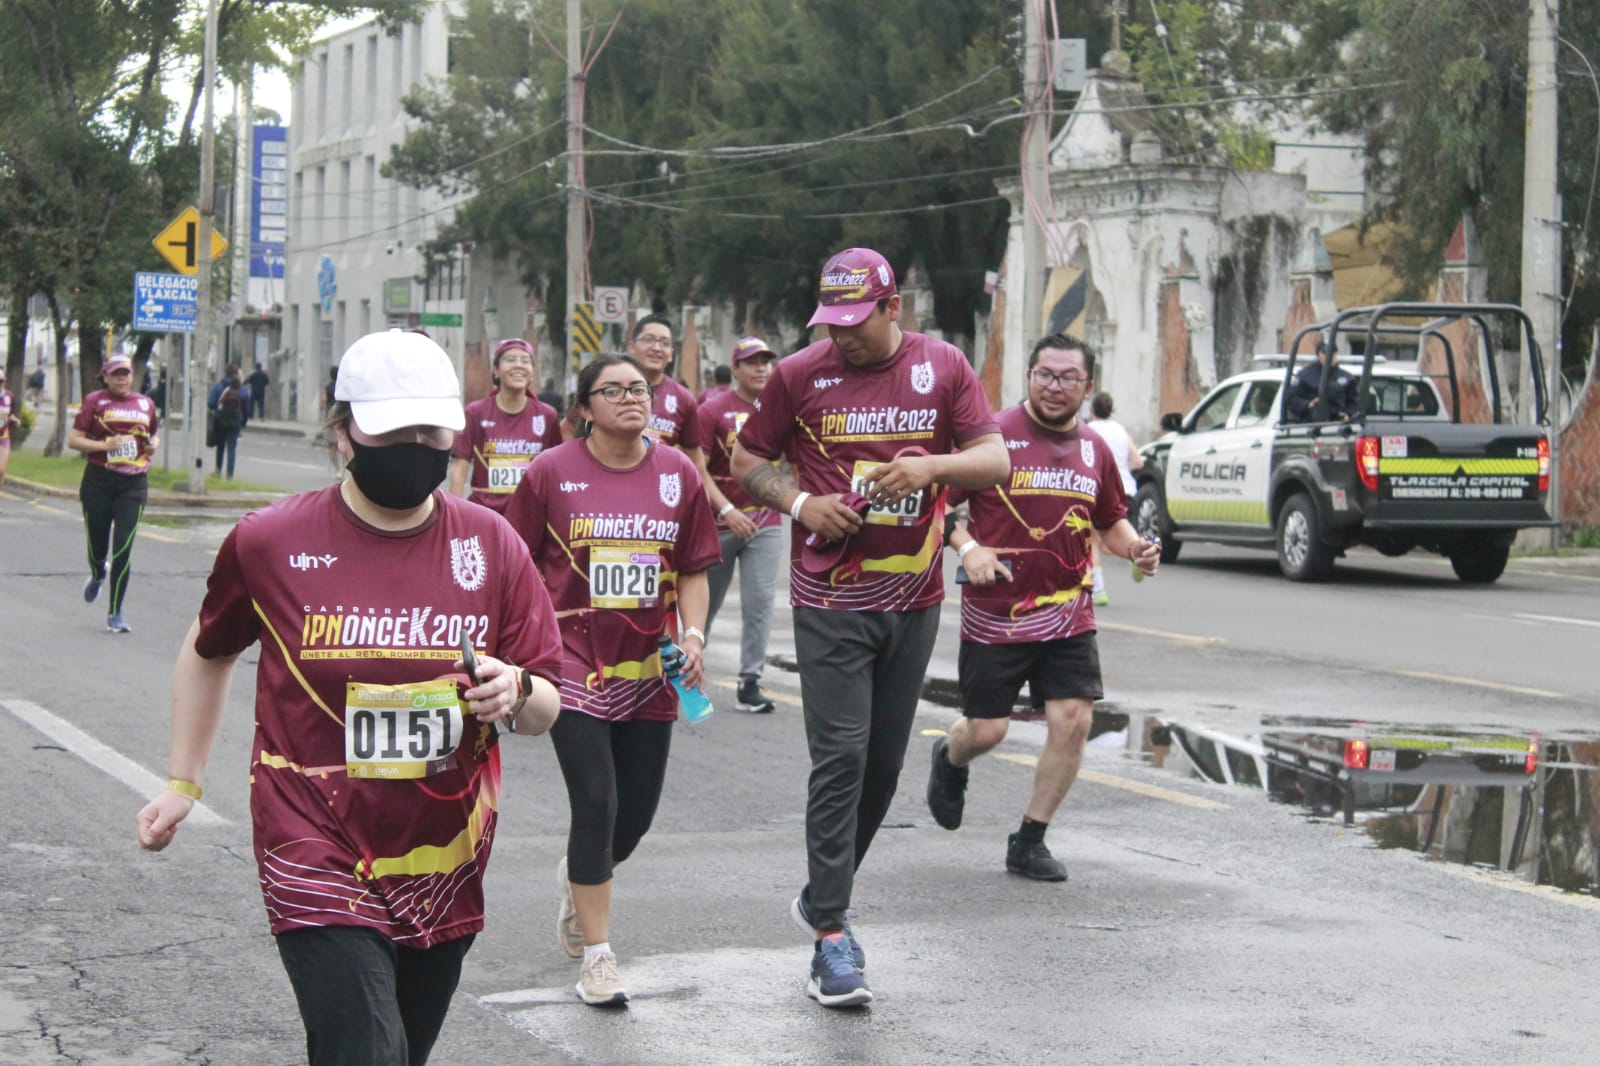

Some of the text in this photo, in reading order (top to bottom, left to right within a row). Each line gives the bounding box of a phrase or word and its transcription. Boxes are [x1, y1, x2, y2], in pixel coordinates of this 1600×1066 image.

[138, 275, 198, 290] DELEGACIO
[140, 287, 198, 300] TLAXCAL
[606, 297, 616, 313] E
[1390, 476, 1530, 486] TLAXCALA CAPITAL
[594, 564, 656, 596] 0026
[304, 605, 408, 614] CARRERA
[353, 708, 455, 759] 0151
